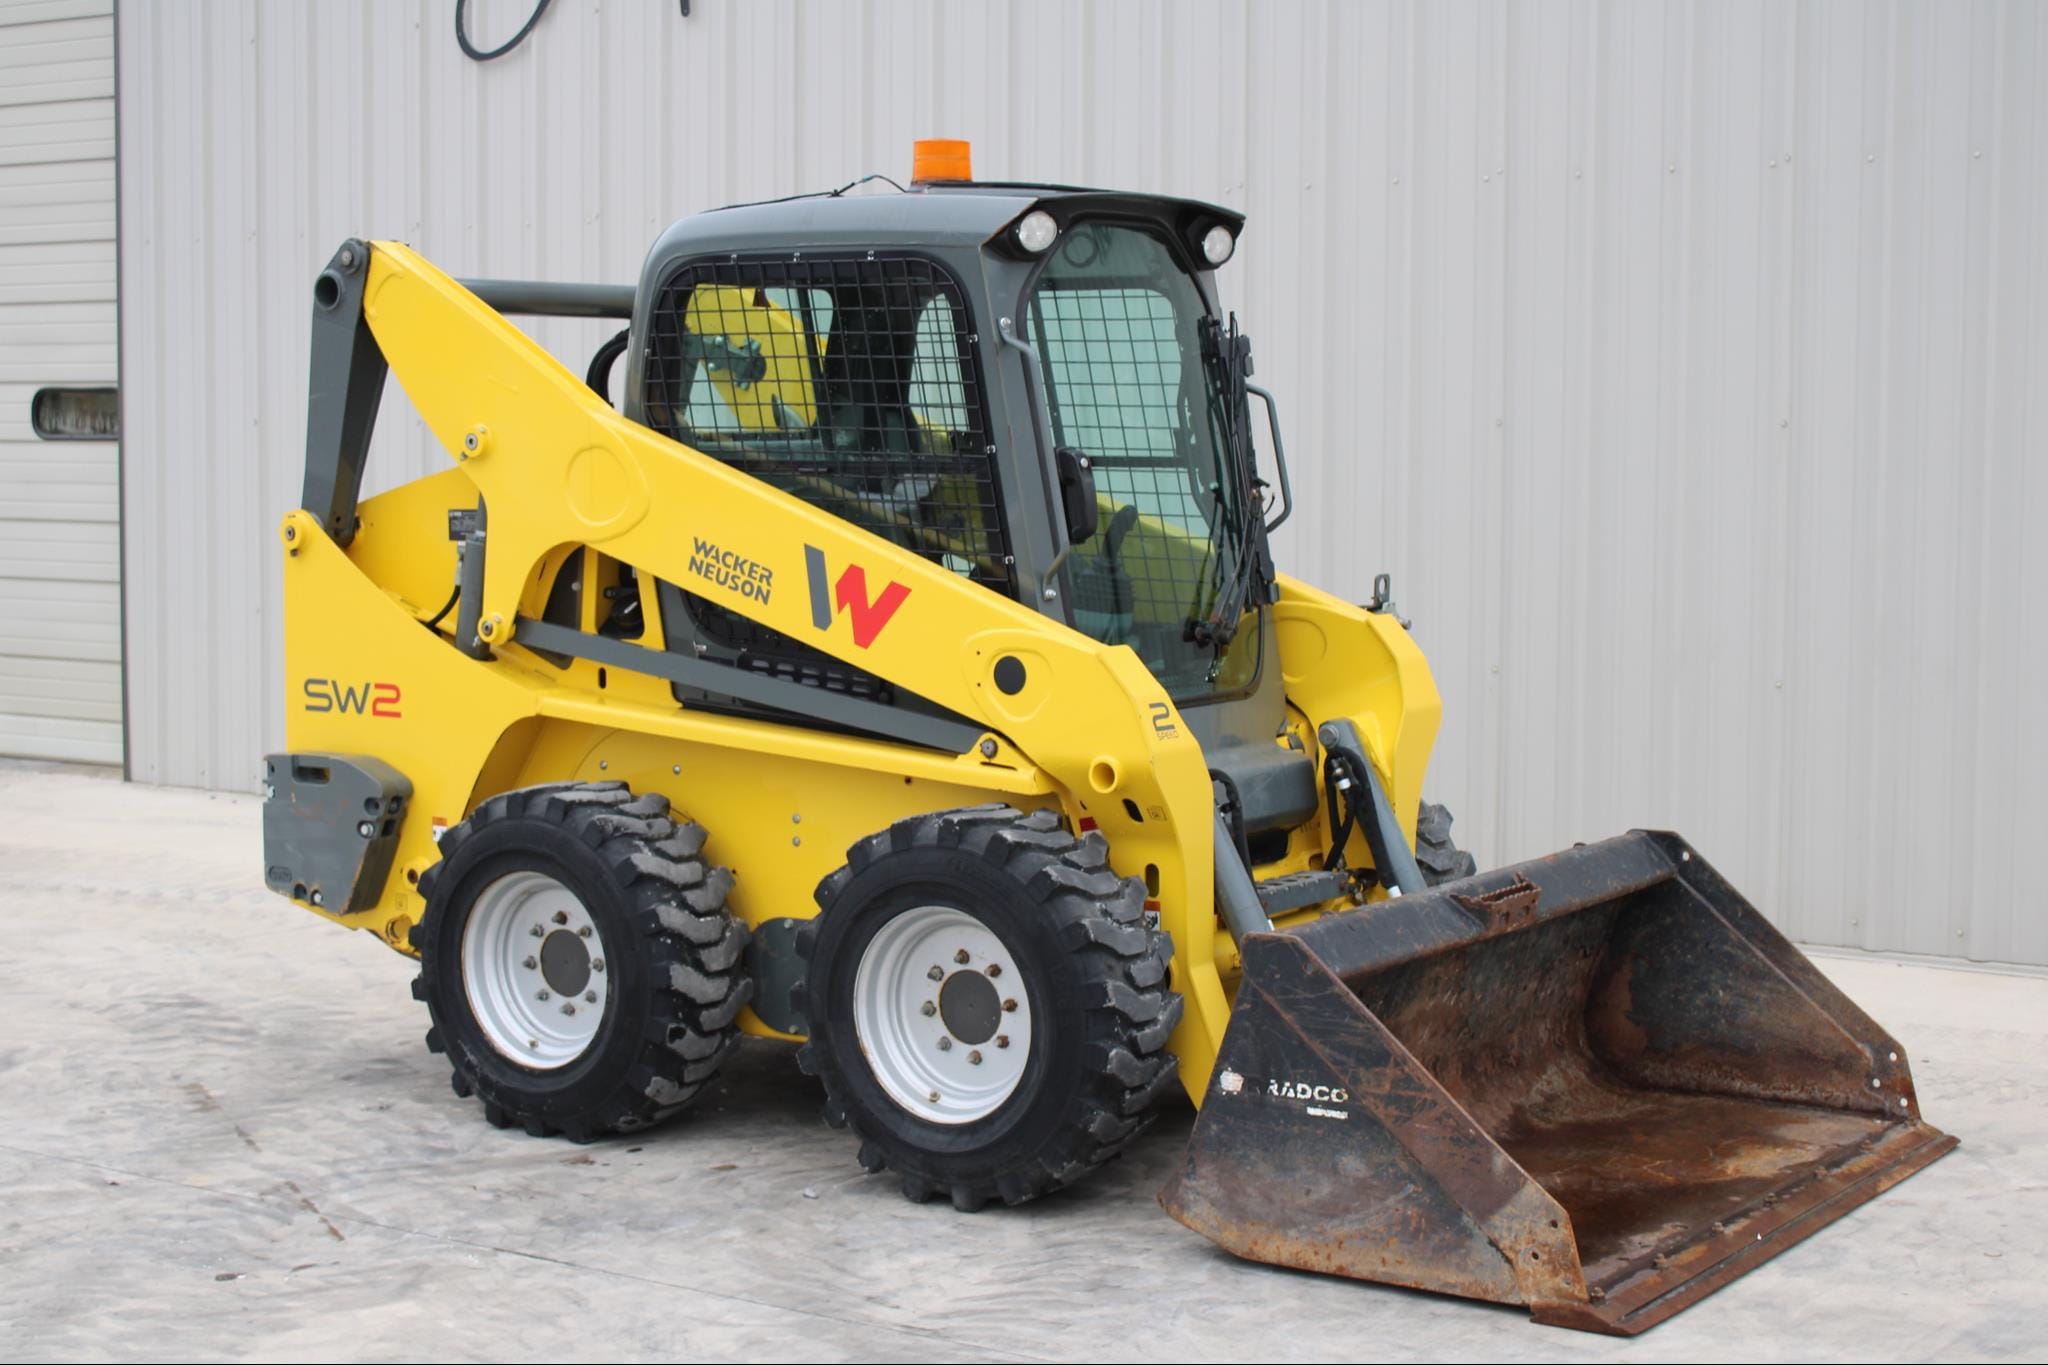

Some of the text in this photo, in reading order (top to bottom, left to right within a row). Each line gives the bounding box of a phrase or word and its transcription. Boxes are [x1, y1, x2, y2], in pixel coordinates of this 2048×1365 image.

[688, 556, 771, 605] NEUSON
[693, 536, 773, 586] WACKER
[304, 678, 402, 718] SW2
[1149, 702, 1176, 731] 2
